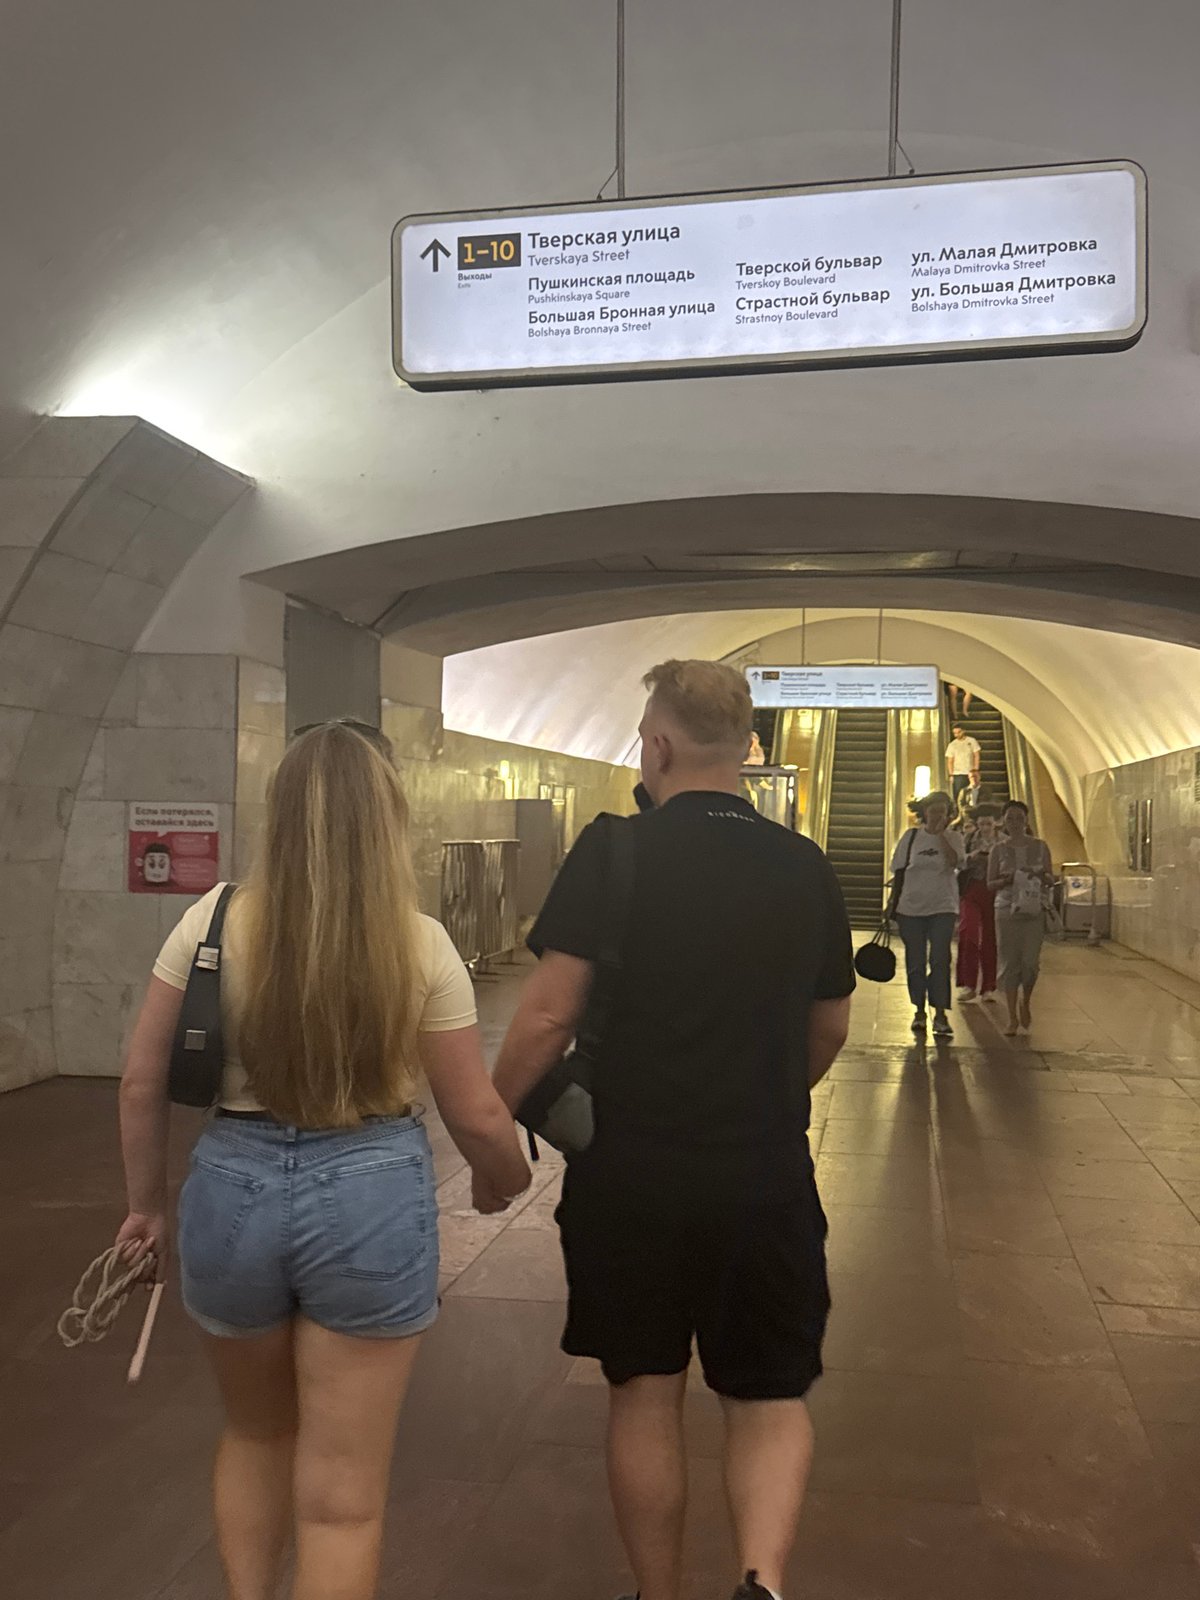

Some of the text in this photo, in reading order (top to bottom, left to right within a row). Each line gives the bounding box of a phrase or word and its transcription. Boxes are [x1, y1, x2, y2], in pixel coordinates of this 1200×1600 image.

[528, 226, 681, 250] Тверская улица
[463, 239, 515, 263] 1-10
[528, 249, 630, 266] Tverskaya Street
[911, 239, 1098, 266] ул. Малая Дмитровка
[736, 255, 883, 277] Тверской бульвар
[911, 259, 1046, 278] Malaya Dmitrovka Street
[457, 272, 492, 282] Выходы
[528, 269, 695, 293] Пушкинская площадь
[736, 273, 836, 290] Tverskoy Boulevard
[528, 290, 630, 304] Pushkinskaya Square
[911, 274, 1116, 301] ул. Большая Дмитровка
[736, 289, 890, 312] Страстной бульвар
[911, 293, 1055, 312] Bolshaya Dmitrovka Street
[528, 302, 716, 324] Большая Бронная улица
[735, 308, 839, 325] Strastnoy Boulevard
[528, 322, 652, 338] Bolshaya Bronnaya Street
